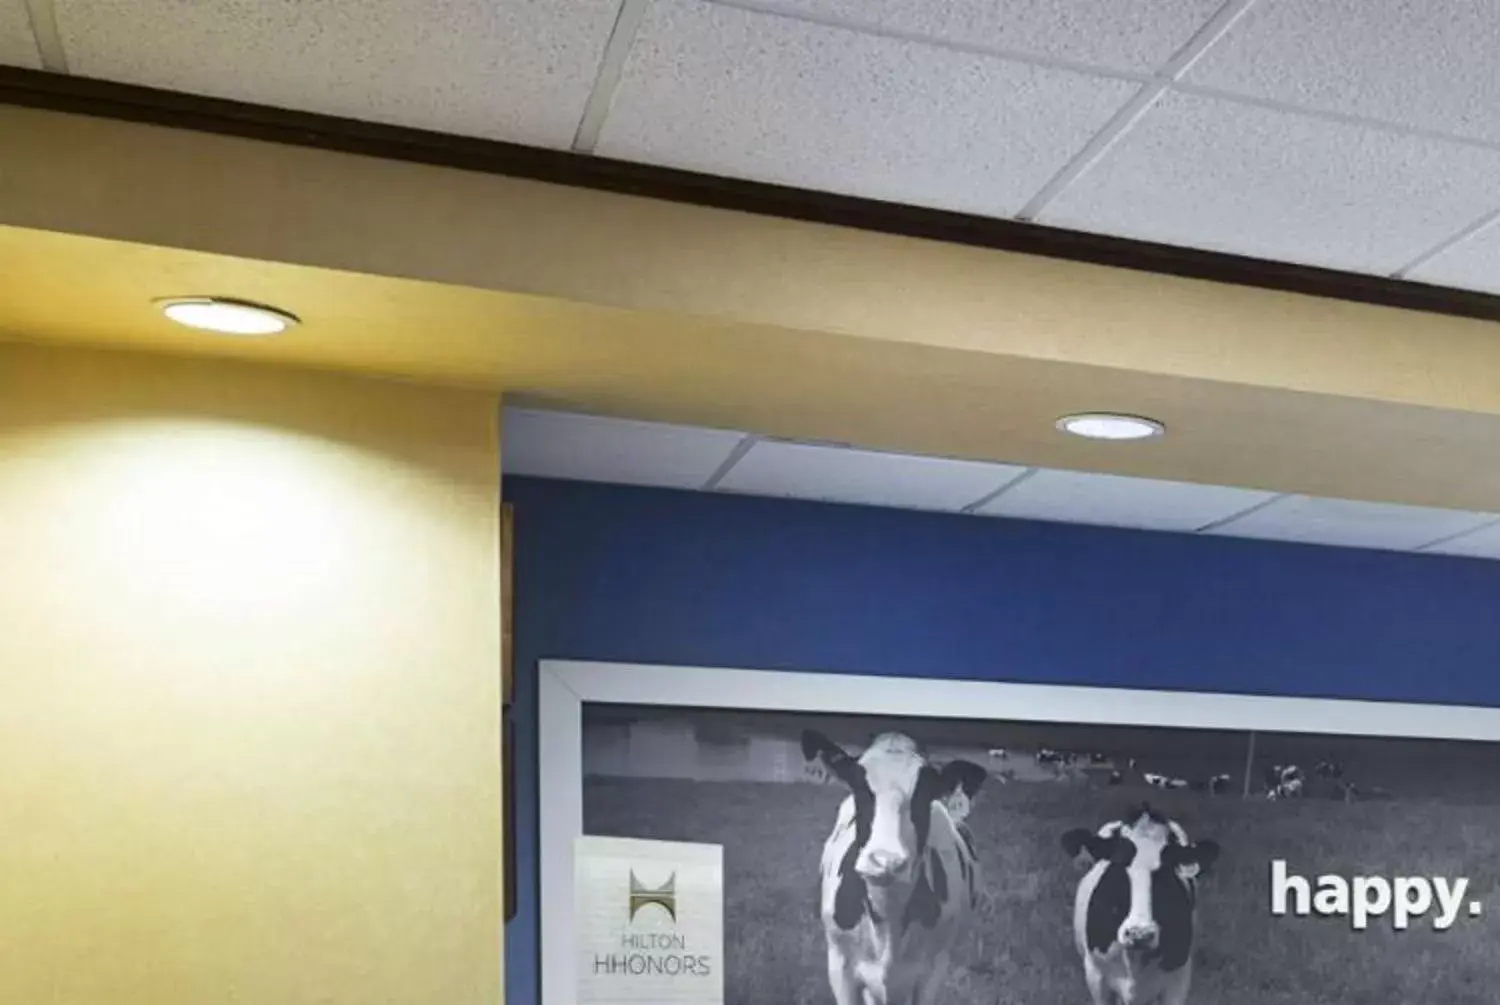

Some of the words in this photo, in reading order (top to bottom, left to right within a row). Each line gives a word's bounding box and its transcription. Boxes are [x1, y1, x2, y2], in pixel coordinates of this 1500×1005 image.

[1271, 859, 1482, 930] happy.
[621, 933, 685, 949] HILTON
[593, 953, 711, 976] HHONORS
